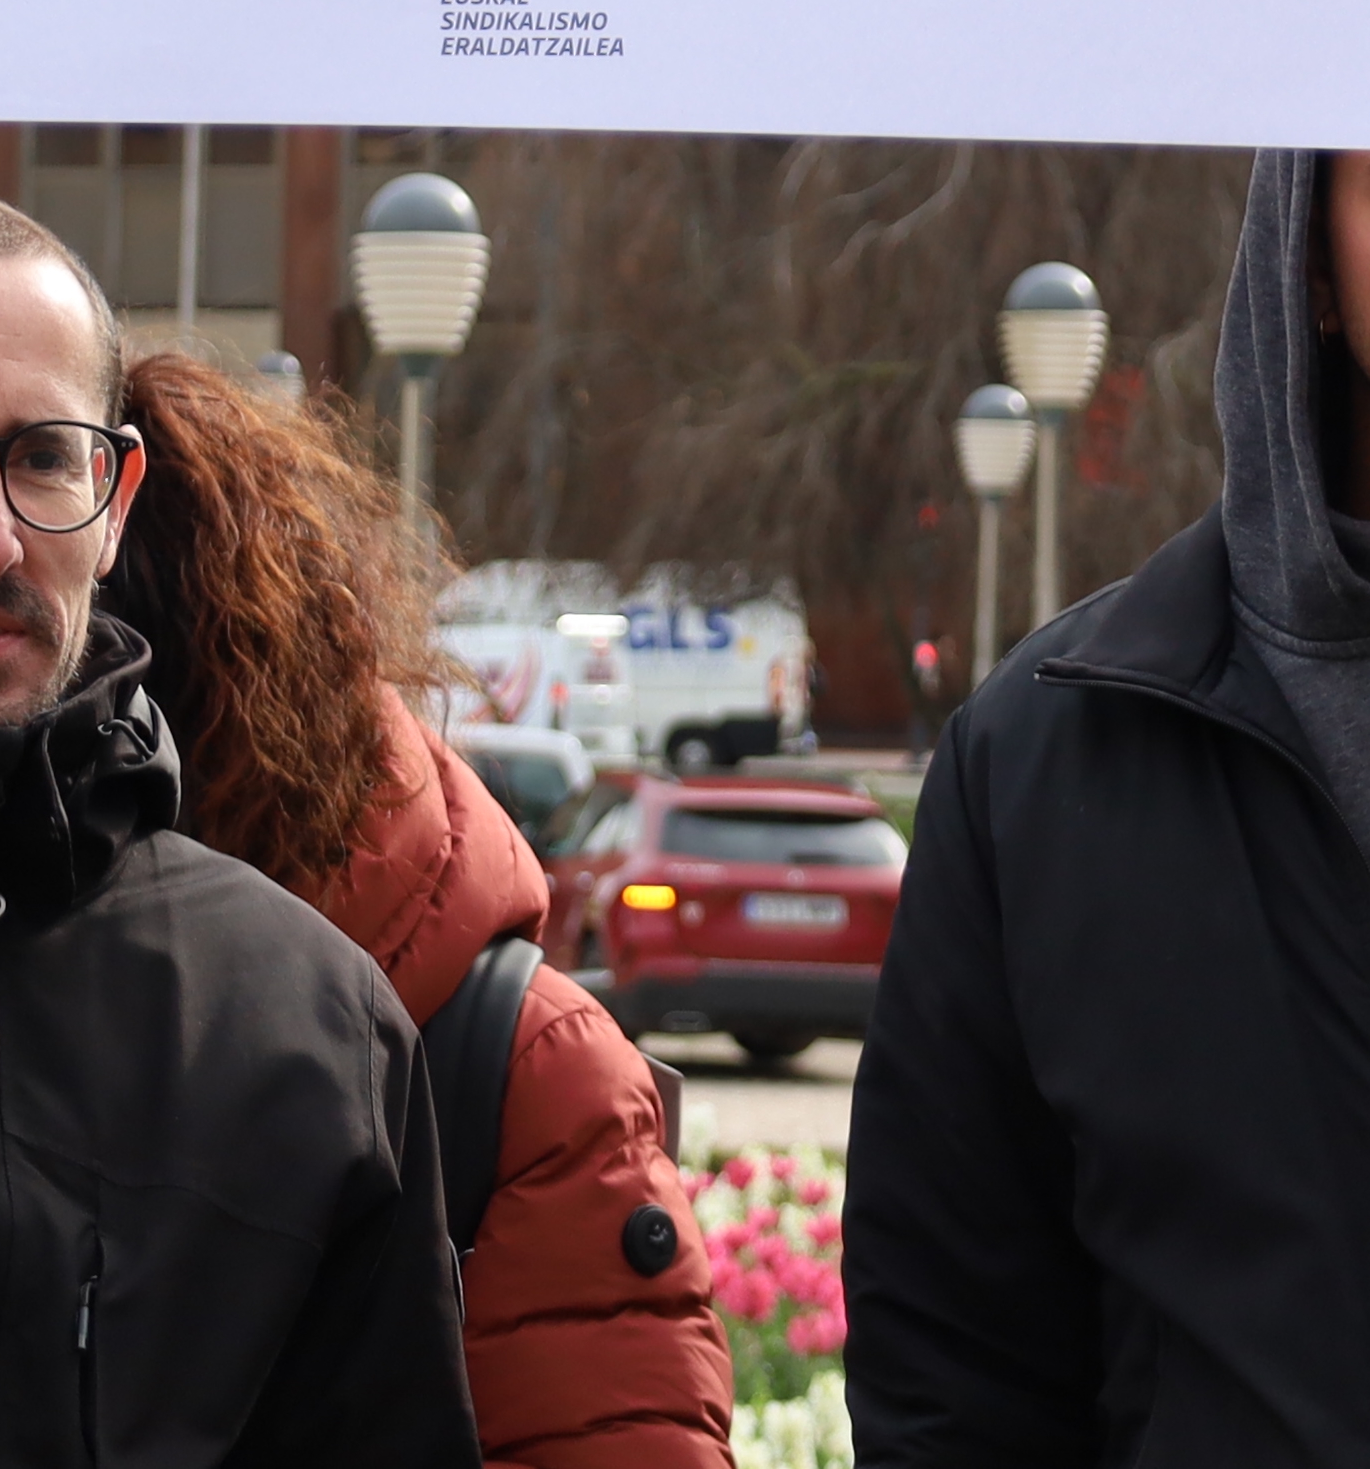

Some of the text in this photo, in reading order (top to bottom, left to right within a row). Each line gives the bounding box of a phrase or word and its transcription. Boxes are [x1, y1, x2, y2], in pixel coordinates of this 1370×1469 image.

[440, 12, 608, 31] SINDIKALISMO
[440, 37, 624, 57] ERALDATZAILEA
[626, 607, 733, 649] GLS
